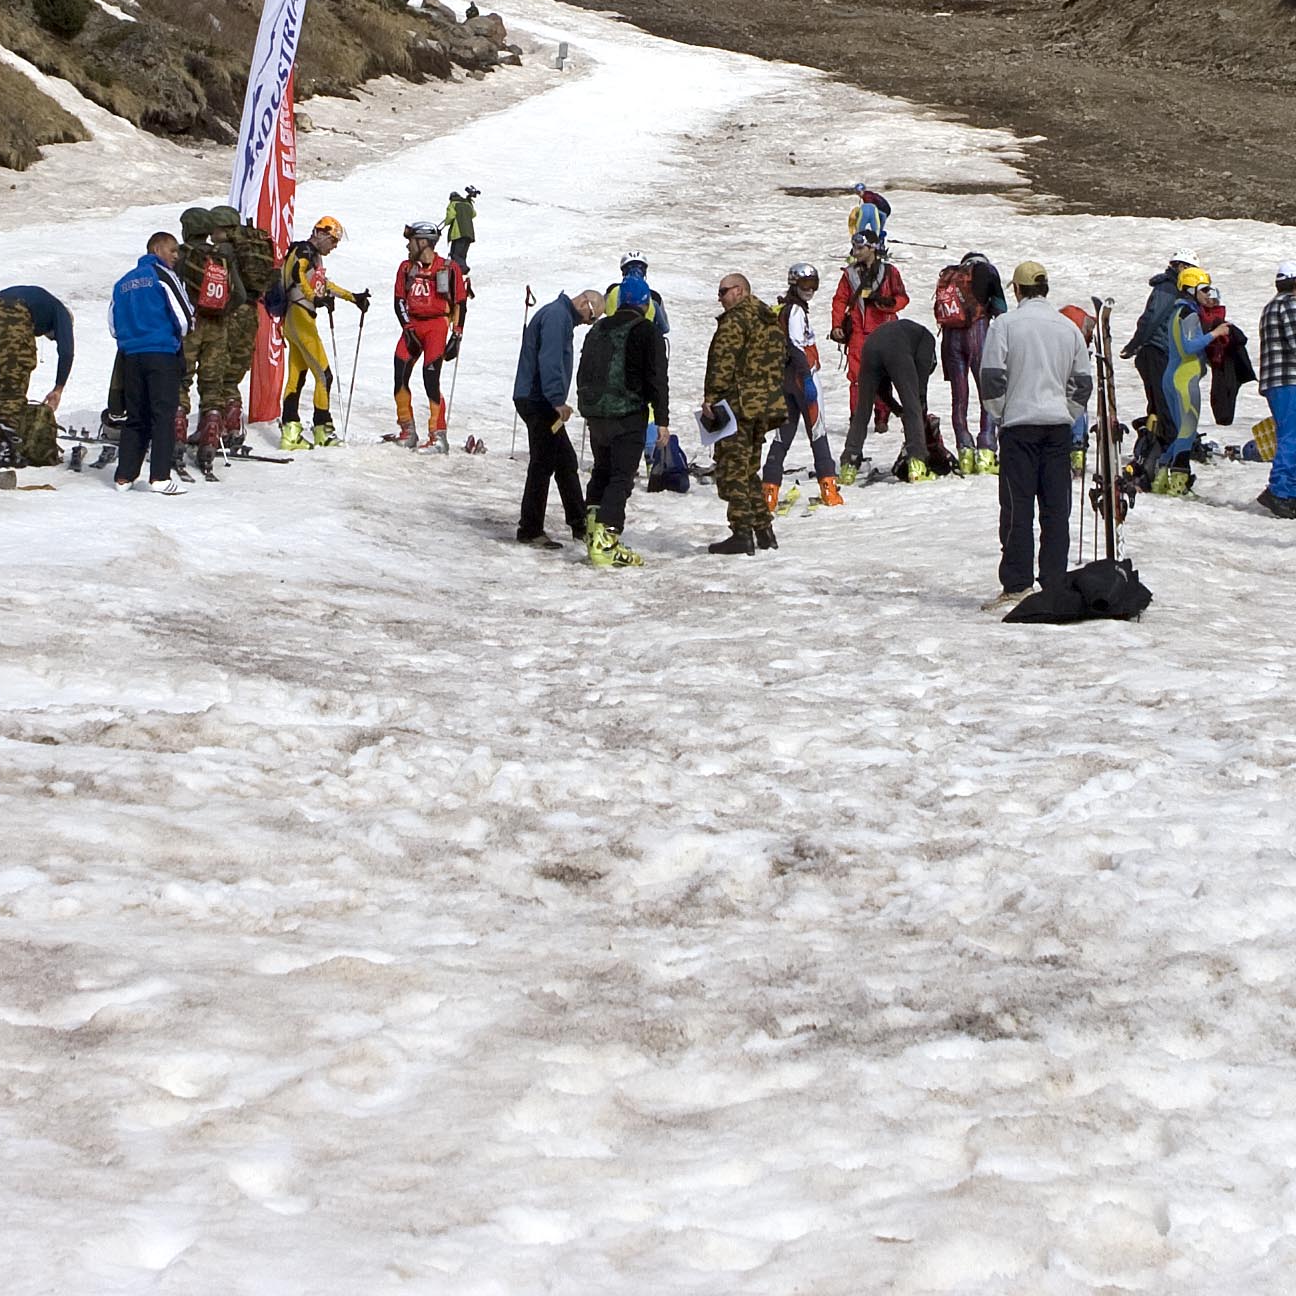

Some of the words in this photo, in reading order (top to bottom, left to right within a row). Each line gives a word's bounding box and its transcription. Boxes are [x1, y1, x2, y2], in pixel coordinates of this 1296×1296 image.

[206, 282, 224, 299] 90
[410, 282, 431, 296] 100
[938, 300, 960, 318] 104
